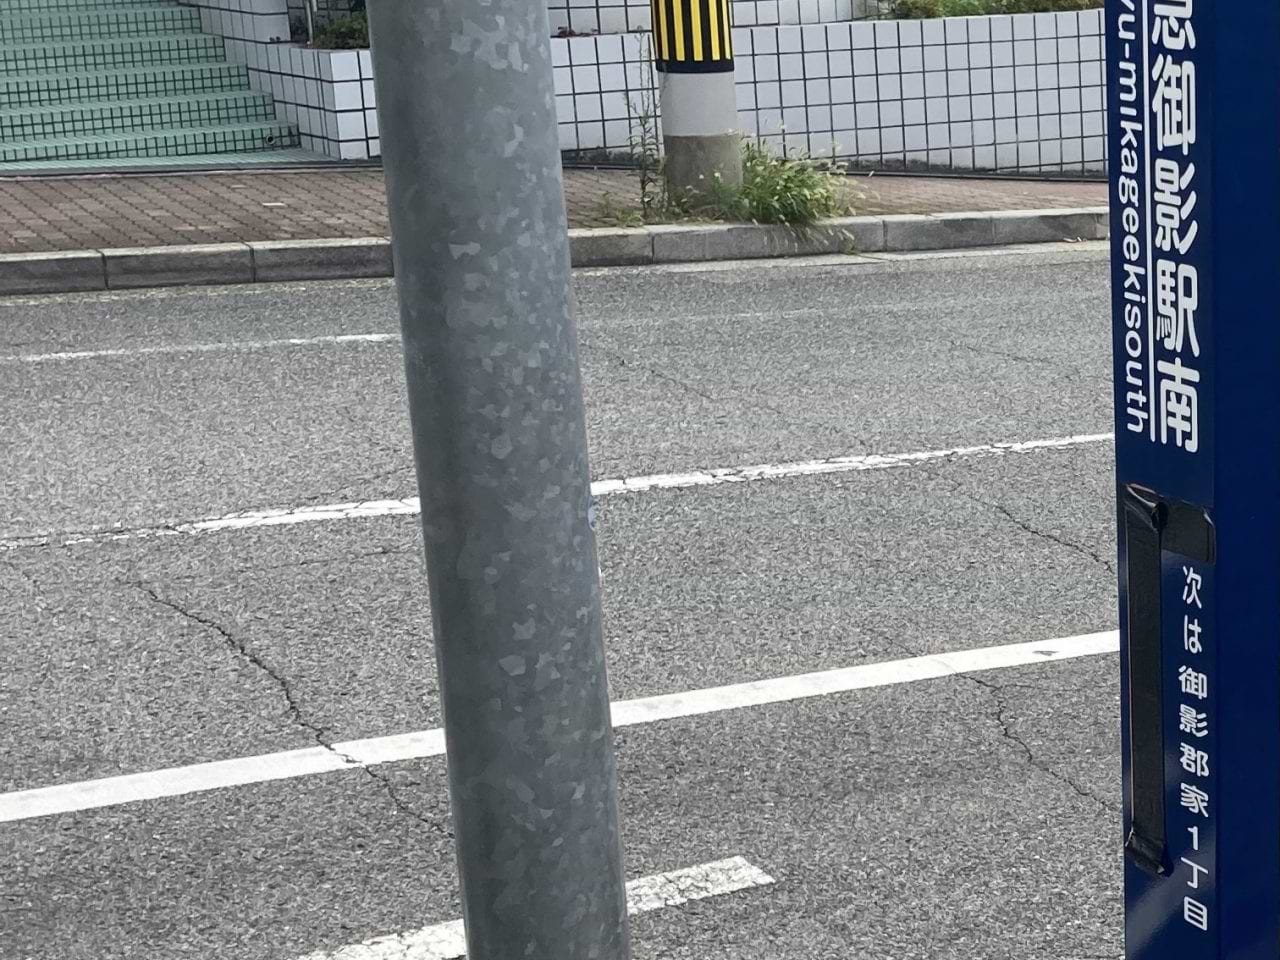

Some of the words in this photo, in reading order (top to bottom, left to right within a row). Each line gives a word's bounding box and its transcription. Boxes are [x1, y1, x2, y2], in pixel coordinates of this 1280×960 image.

[1178, 565, 1209, 931] 次は御影郡家1丁目
